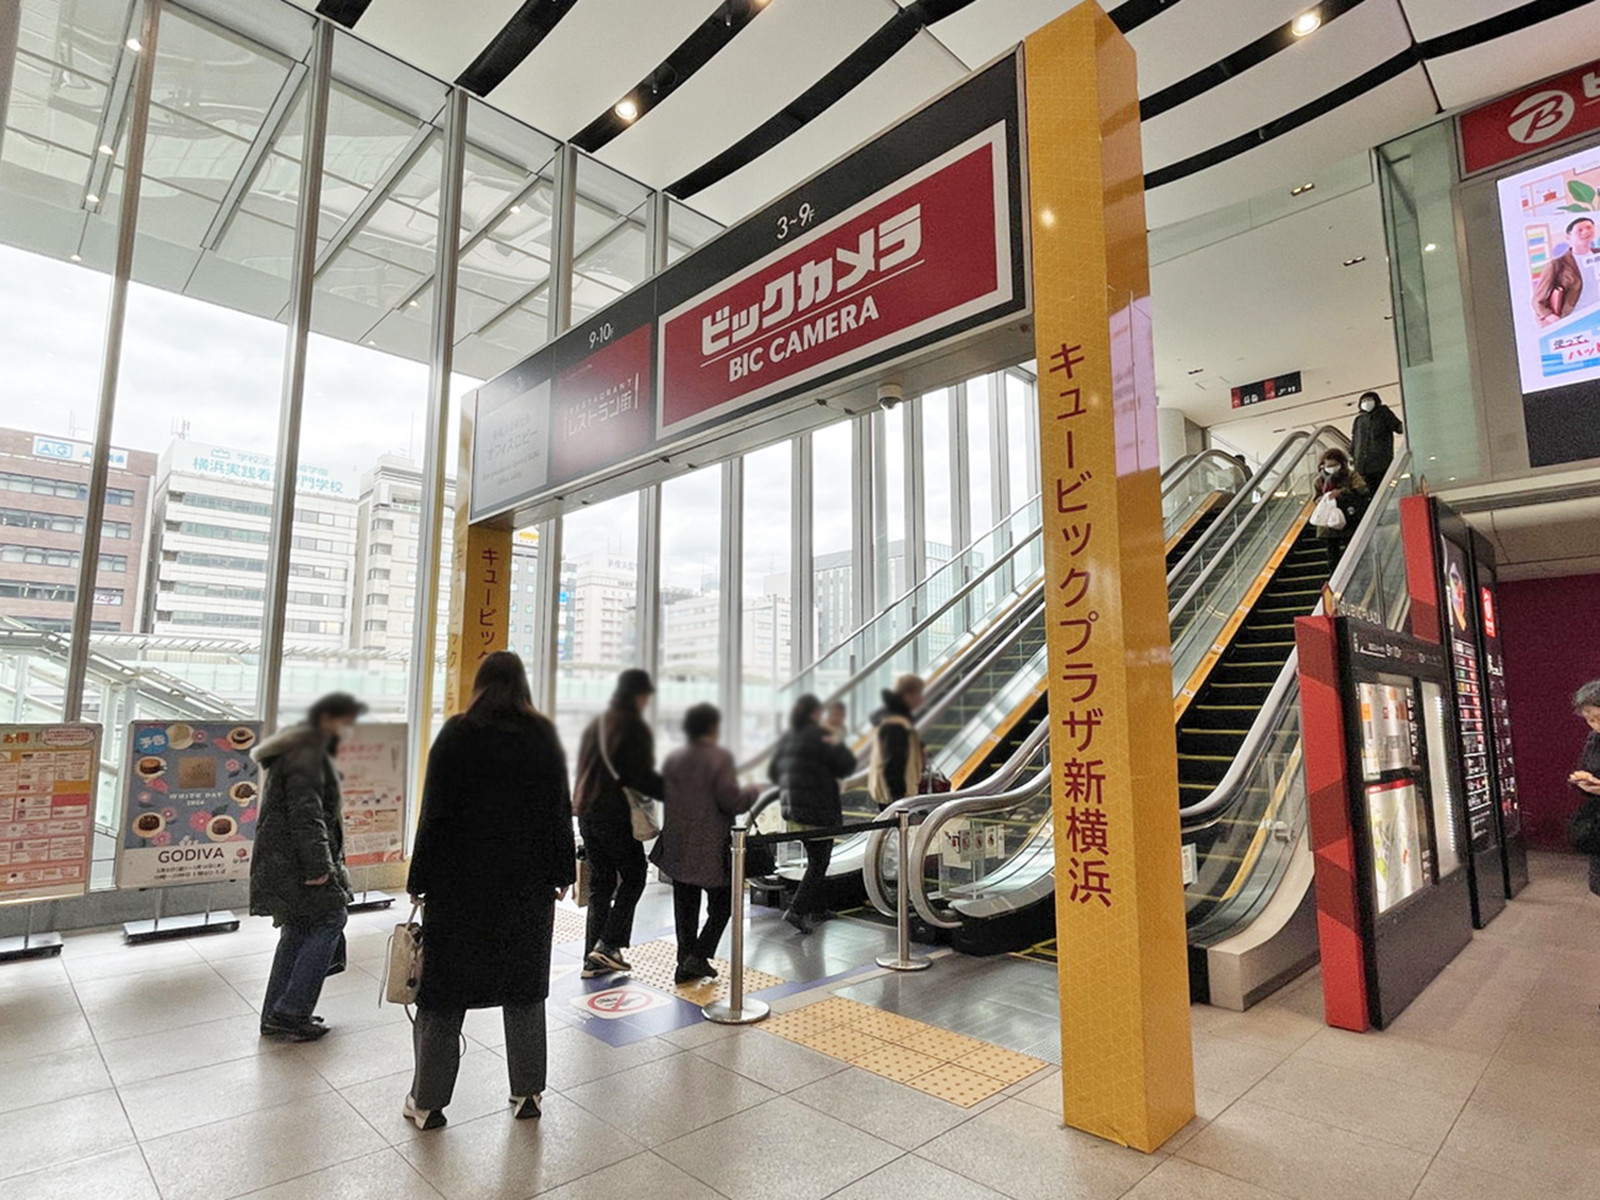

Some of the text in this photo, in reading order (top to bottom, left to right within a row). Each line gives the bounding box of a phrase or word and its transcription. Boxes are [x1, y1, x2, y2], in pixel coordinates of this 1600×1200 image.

[701, 203, 922, 356] ビックカメラ
[729, 295, 880, 383] BIC CAMERA
[1049, 343, 1112, 907] キュービックプラザ新横浜
[204, 791, 222, 799] DAY
[158, 847, 224, 863] GODIVA
